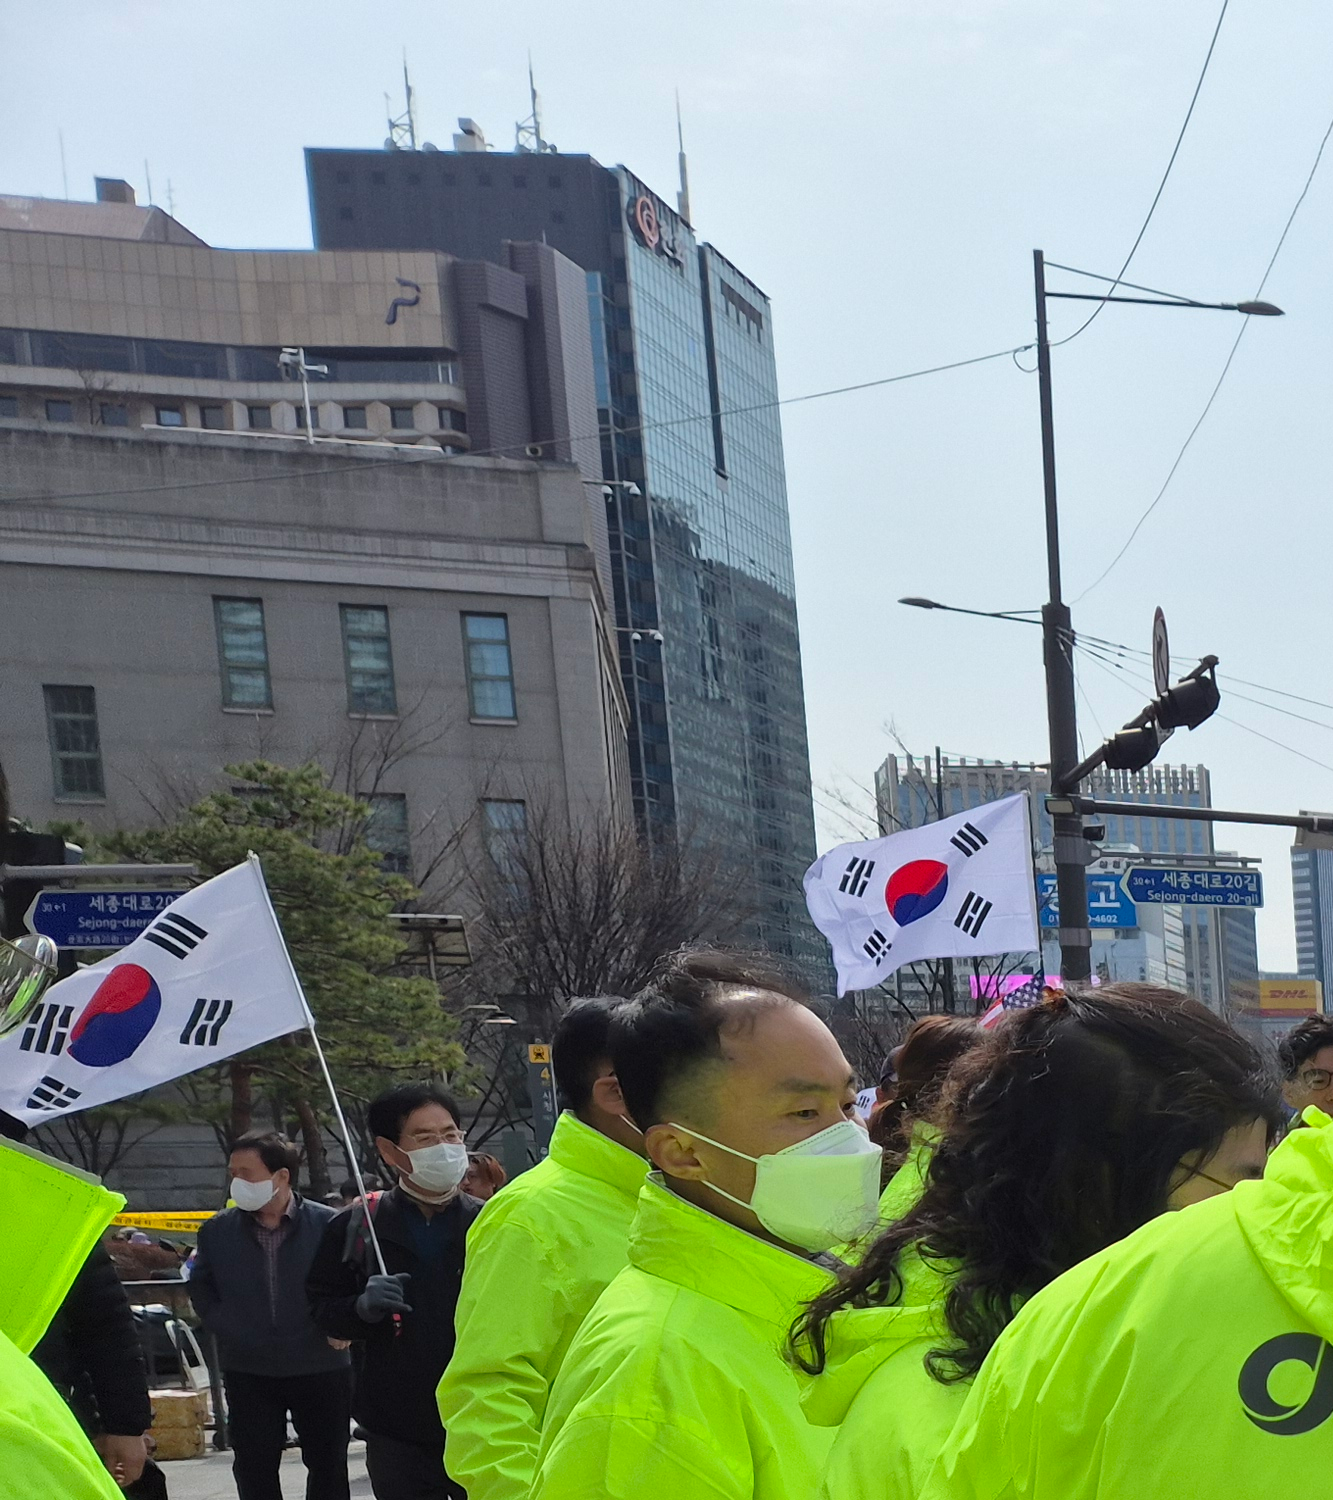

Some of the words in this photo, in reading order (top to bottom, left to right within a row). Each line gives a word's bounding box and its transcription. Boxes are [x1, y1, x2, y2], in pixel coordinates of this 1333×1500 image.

[1161, 871, 1258, 892] 세종대로20길
[89, 894, 182, 914] 세종대로20
[1147, 890, 1223, 904] Sejong-daero
[1226, 892, 1259, 906] 20-gil
[1269, 990, 1309, 999] DHL
